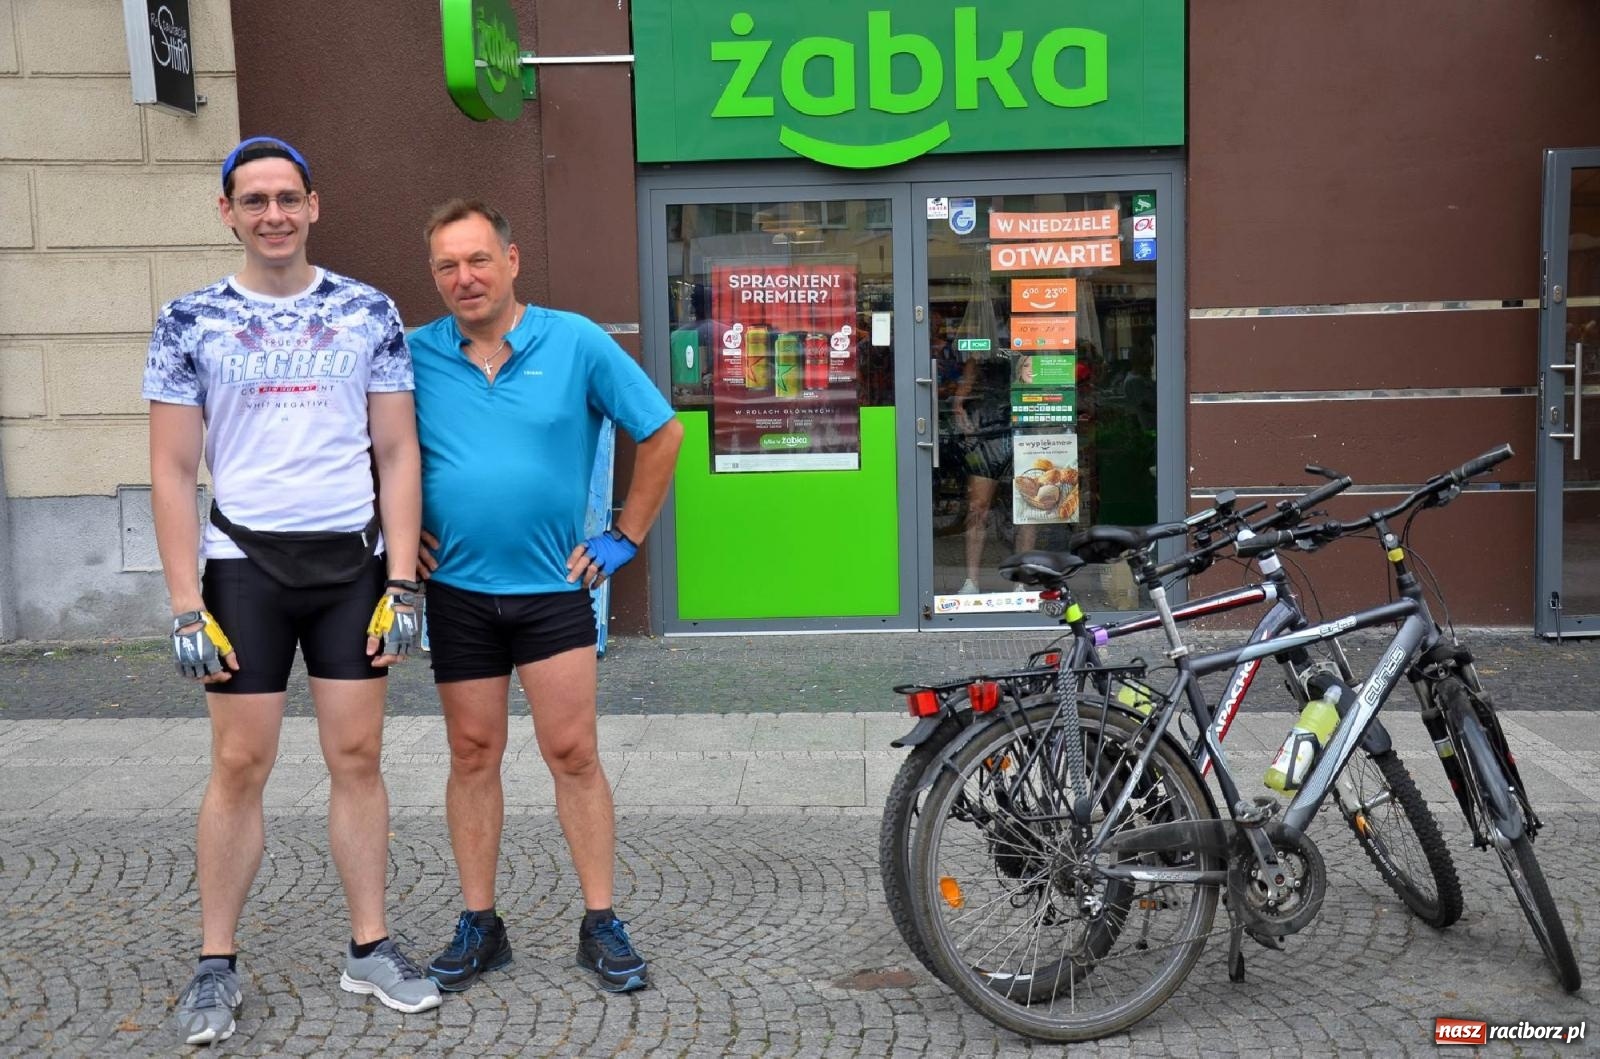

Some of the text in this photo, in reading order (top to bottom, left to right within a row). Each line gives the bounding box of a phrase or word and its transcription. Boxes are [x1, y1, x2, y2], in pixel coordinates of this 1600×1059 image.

[711, 6, 1108, 118] żabka
[996, 215, 1112, 233] W NIEDZIELE
[997, 243, 1114, 268] OTWARTE
[729, 274, 841, 288] SPRAGNIENI
[741, 290, 829, 304] PREMIER?
[221, 349, 358, 384] REGRED
